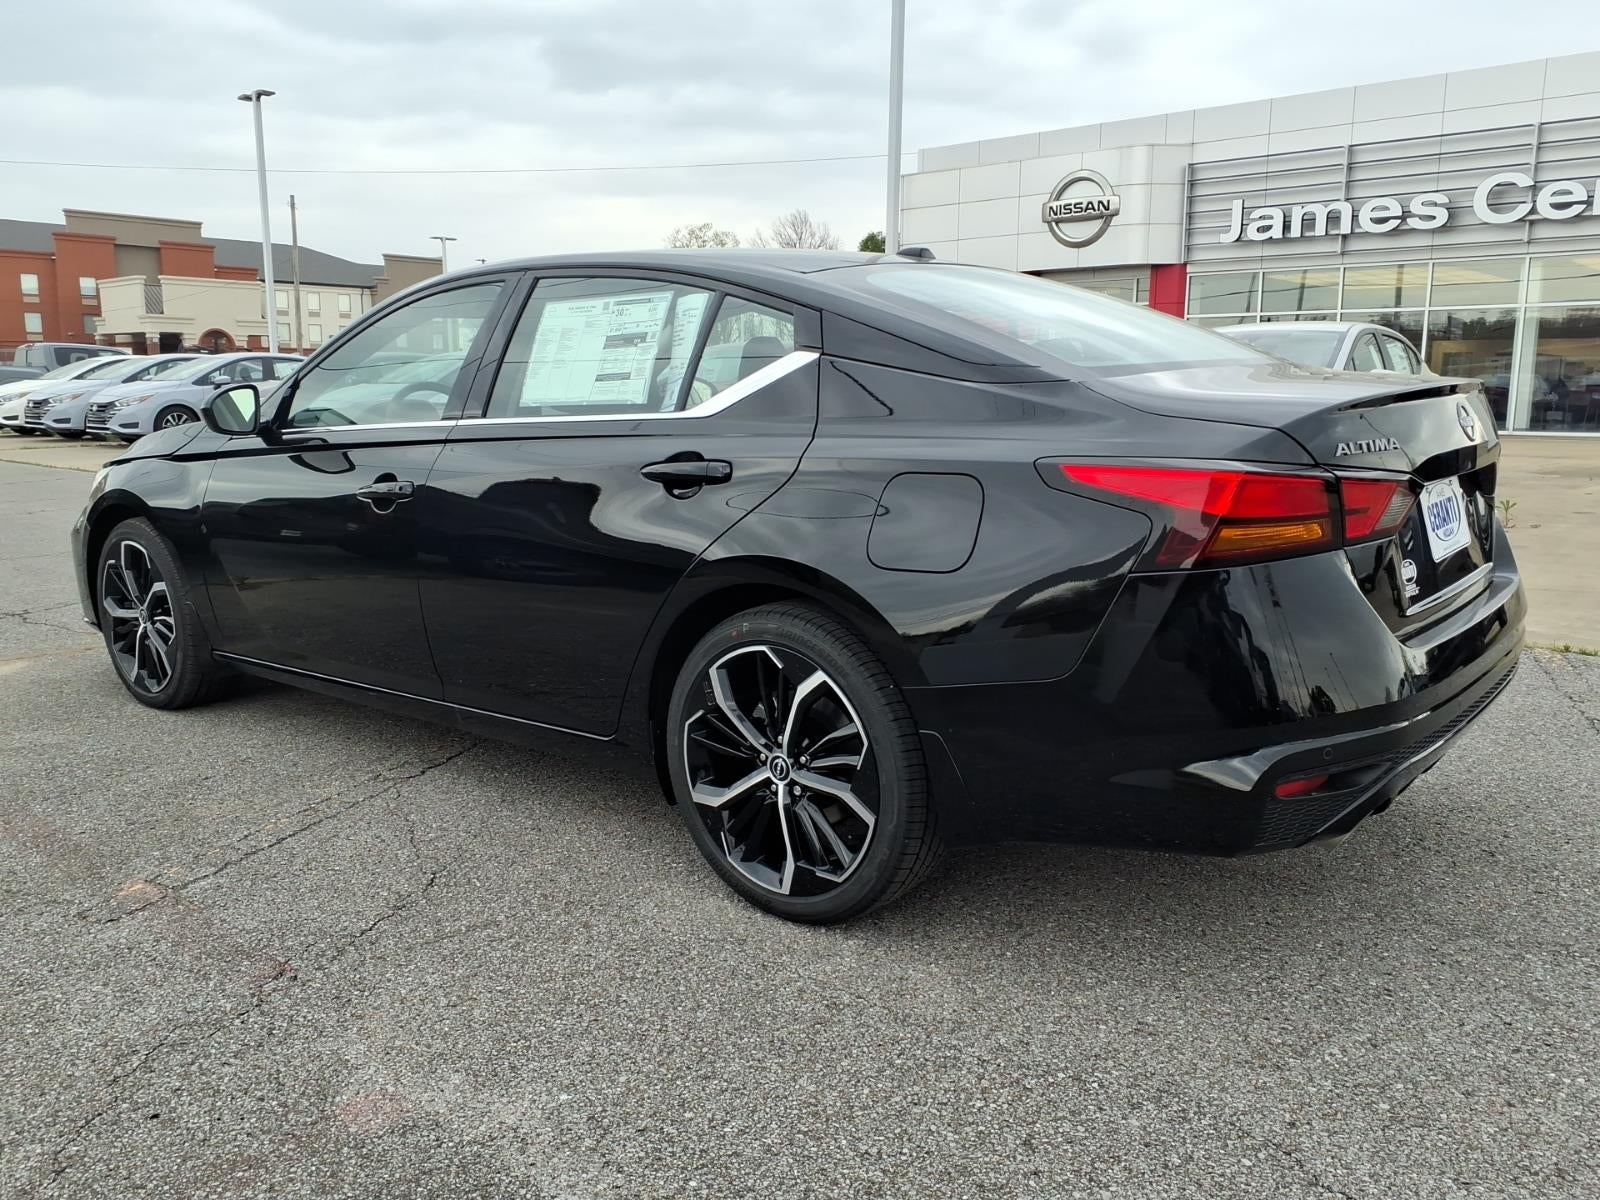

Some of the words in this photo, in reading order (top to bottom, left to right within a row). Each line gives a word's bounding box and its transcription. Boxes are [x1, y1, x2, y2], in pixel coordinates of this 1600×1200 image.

[1048, 199, 1111, 218] NISSAN
[1219, 193, 1451, 244] James
[1472, 172, 1600, 224] Ce
[1334, 437, 1400, 457] ALTIMA
